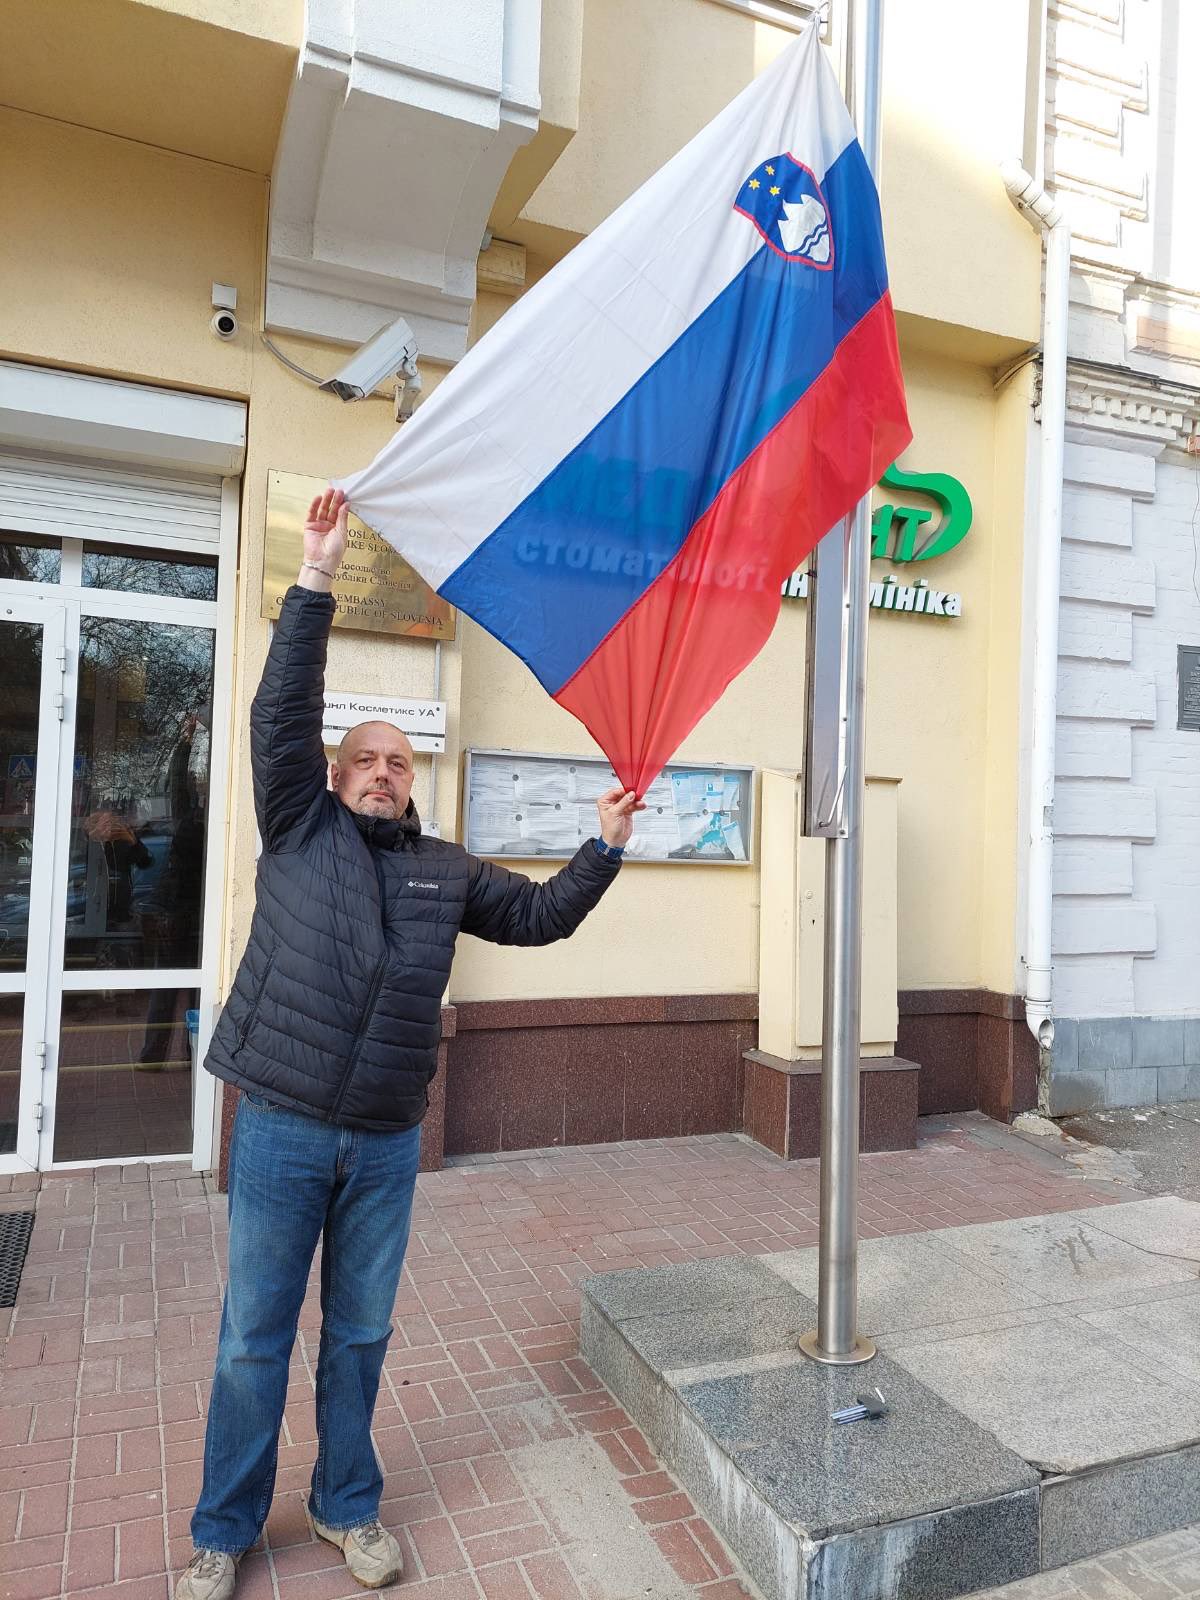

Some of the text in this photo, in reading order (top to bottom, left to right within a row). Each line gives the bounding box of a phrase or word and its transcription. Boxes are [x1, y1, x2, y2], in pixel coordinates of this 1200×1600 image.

[337, 593, 385, 607] EMBASSY
[374, 611, 388, 619] OF
[391, 611, 443, 626] SLOVENIA
[349, 702, 415, 716] Косметикс
[418, 708, 435, 718] УА
